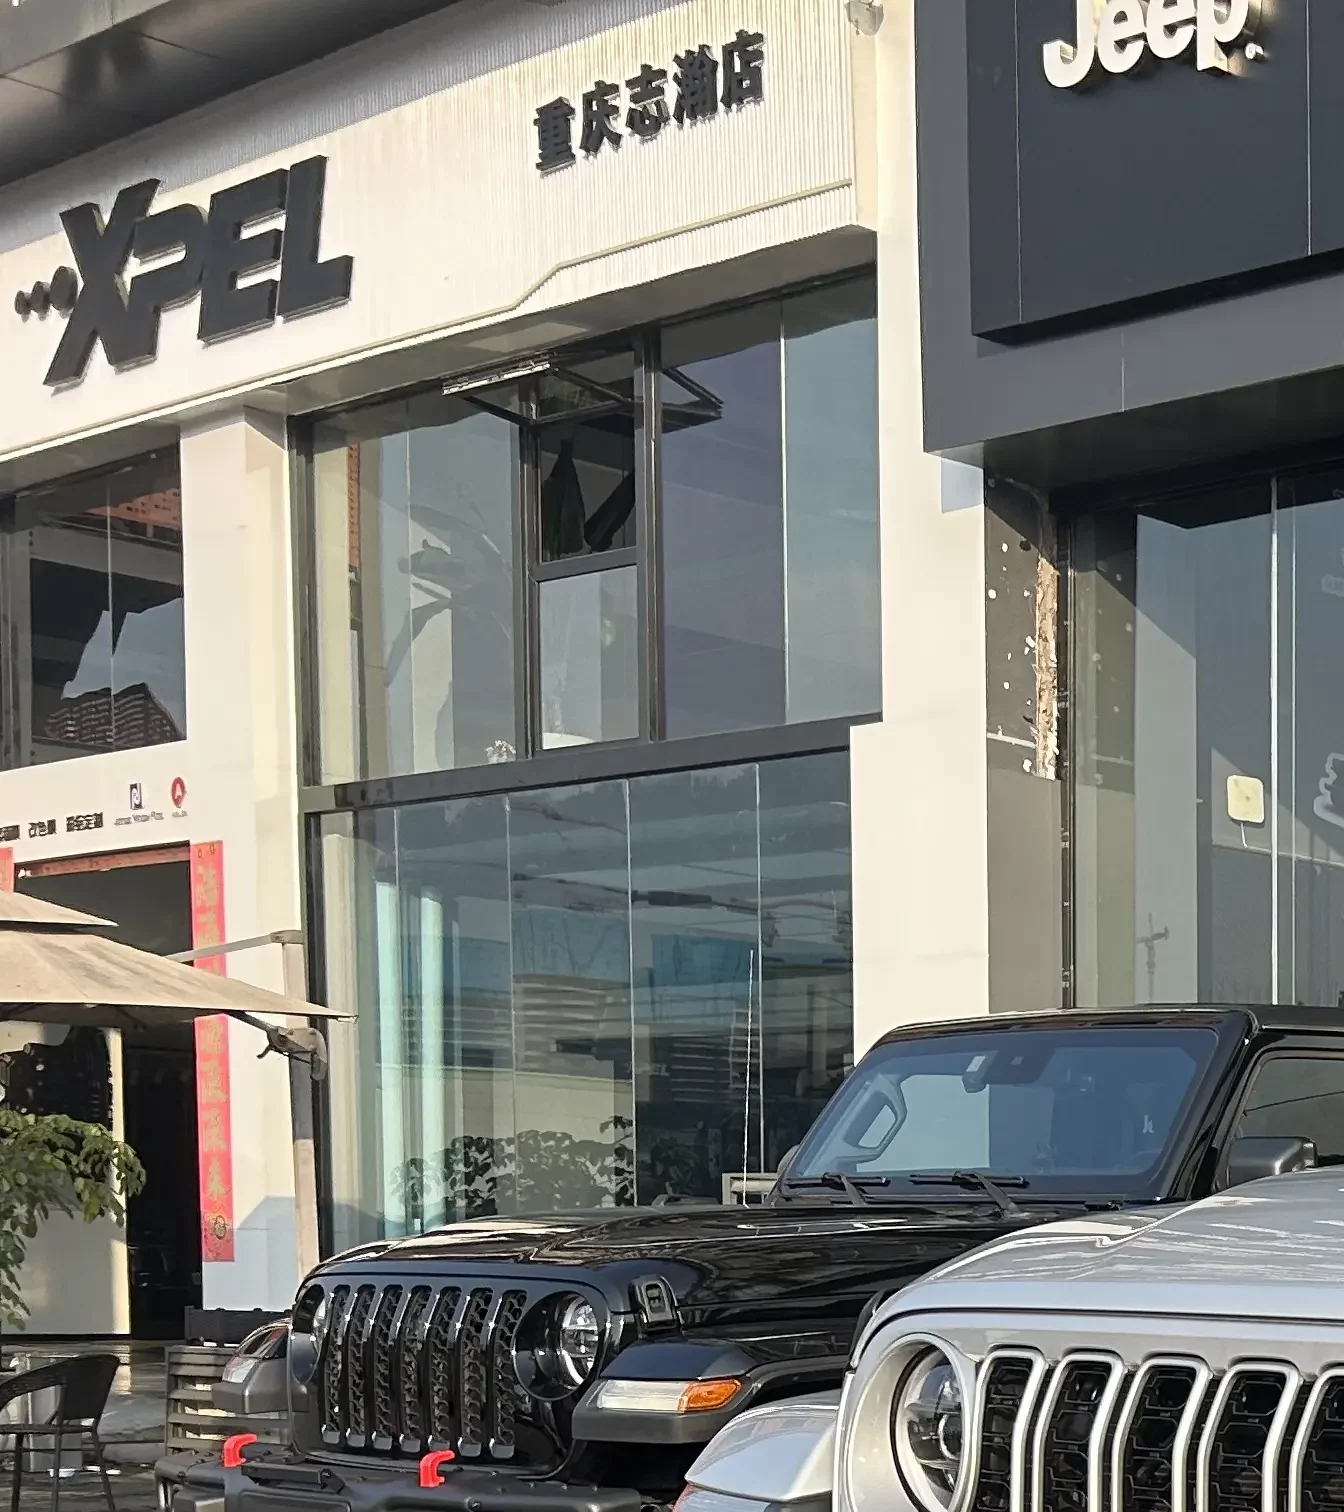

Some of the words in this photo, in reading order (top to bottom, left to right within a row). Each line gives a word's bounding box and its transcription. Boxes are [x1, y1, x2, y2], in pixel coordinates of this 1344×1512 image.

[533, 29, 765, 178] 重庆志瀚店
[44, 154, 354, 390] XPEL
